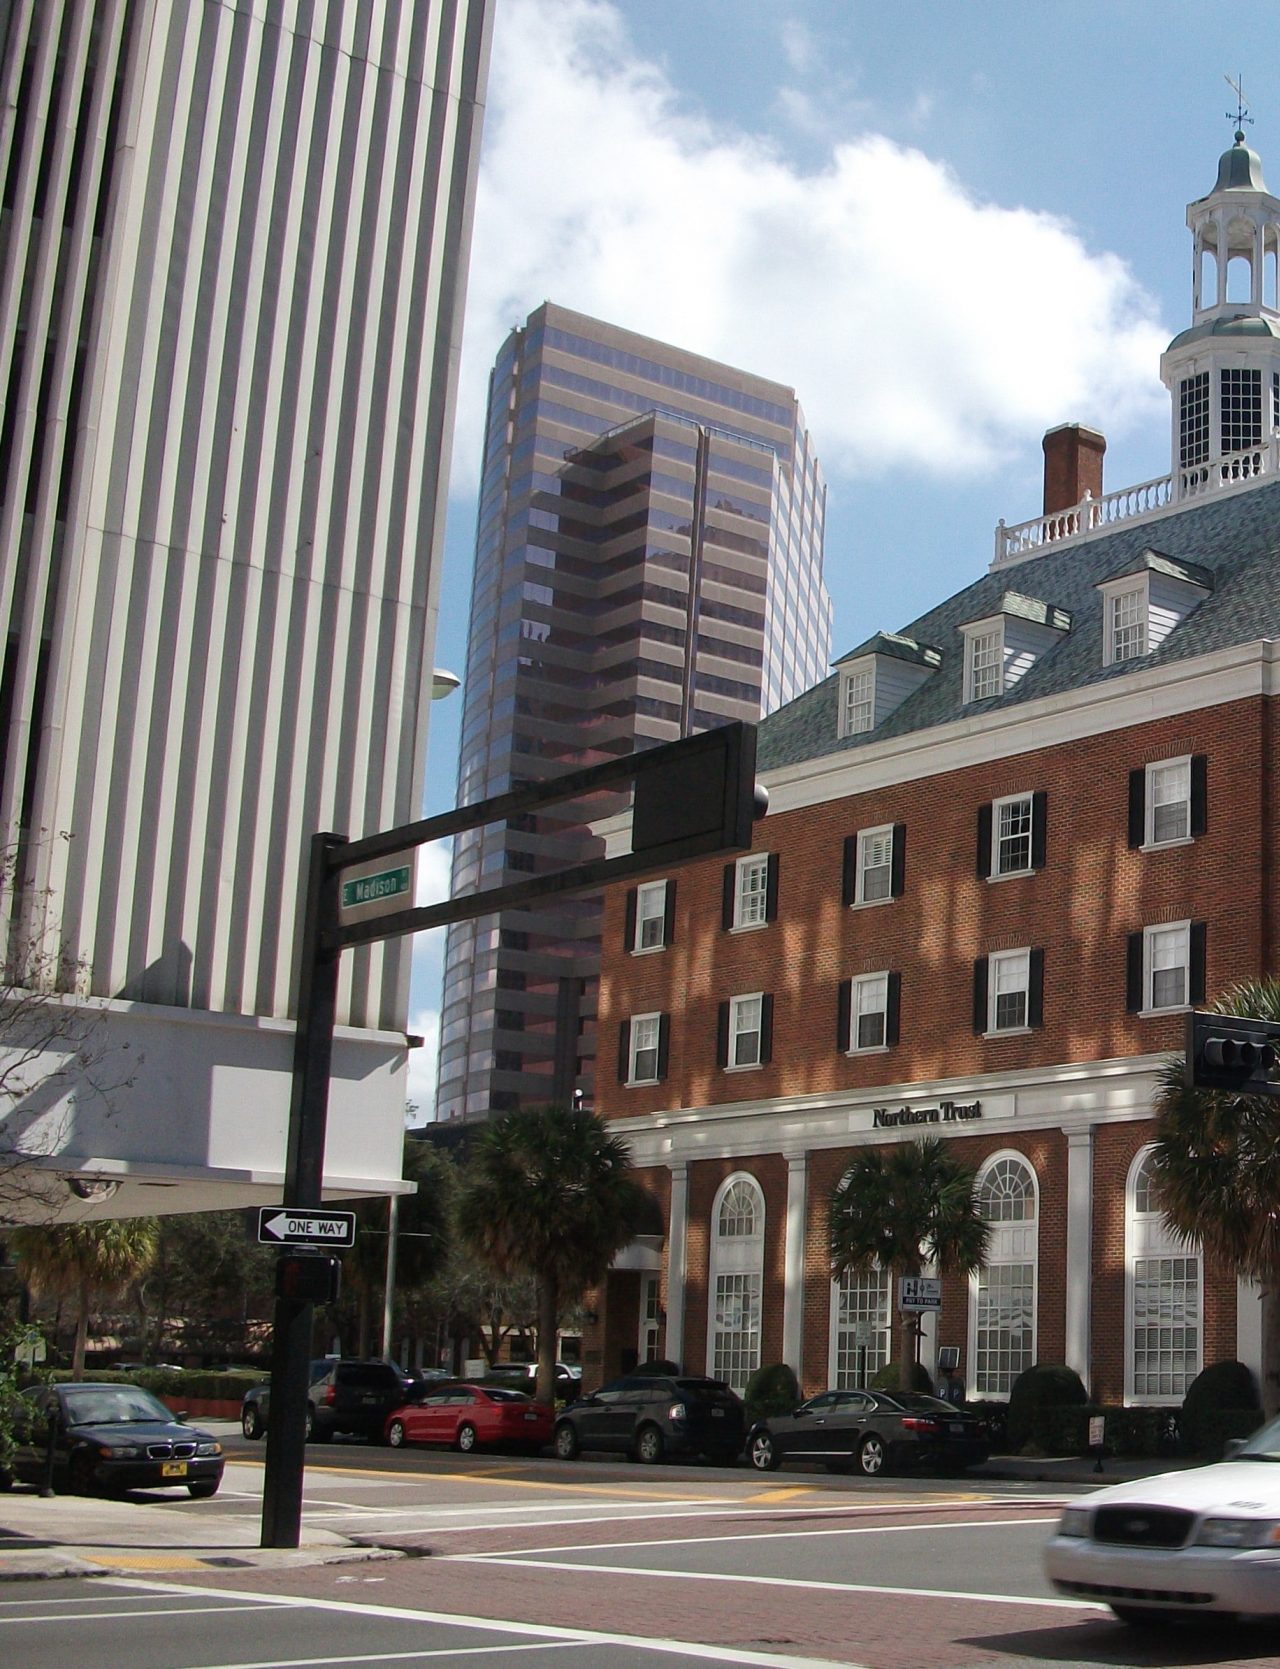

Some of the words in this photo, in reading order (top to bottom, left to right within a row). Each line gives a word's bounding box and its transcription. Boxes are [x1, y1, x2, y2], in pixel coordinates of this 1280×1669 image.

[356, 877, 397, 901] Madison
[873, 1106, 939, 1128] Northern
[940, 1100, 982, 1121] Trust
[288, 1220, 313, 1234] ONE
[318, 1222, 344, 1235] WAY
[940, 1388, 946, 1398] P
